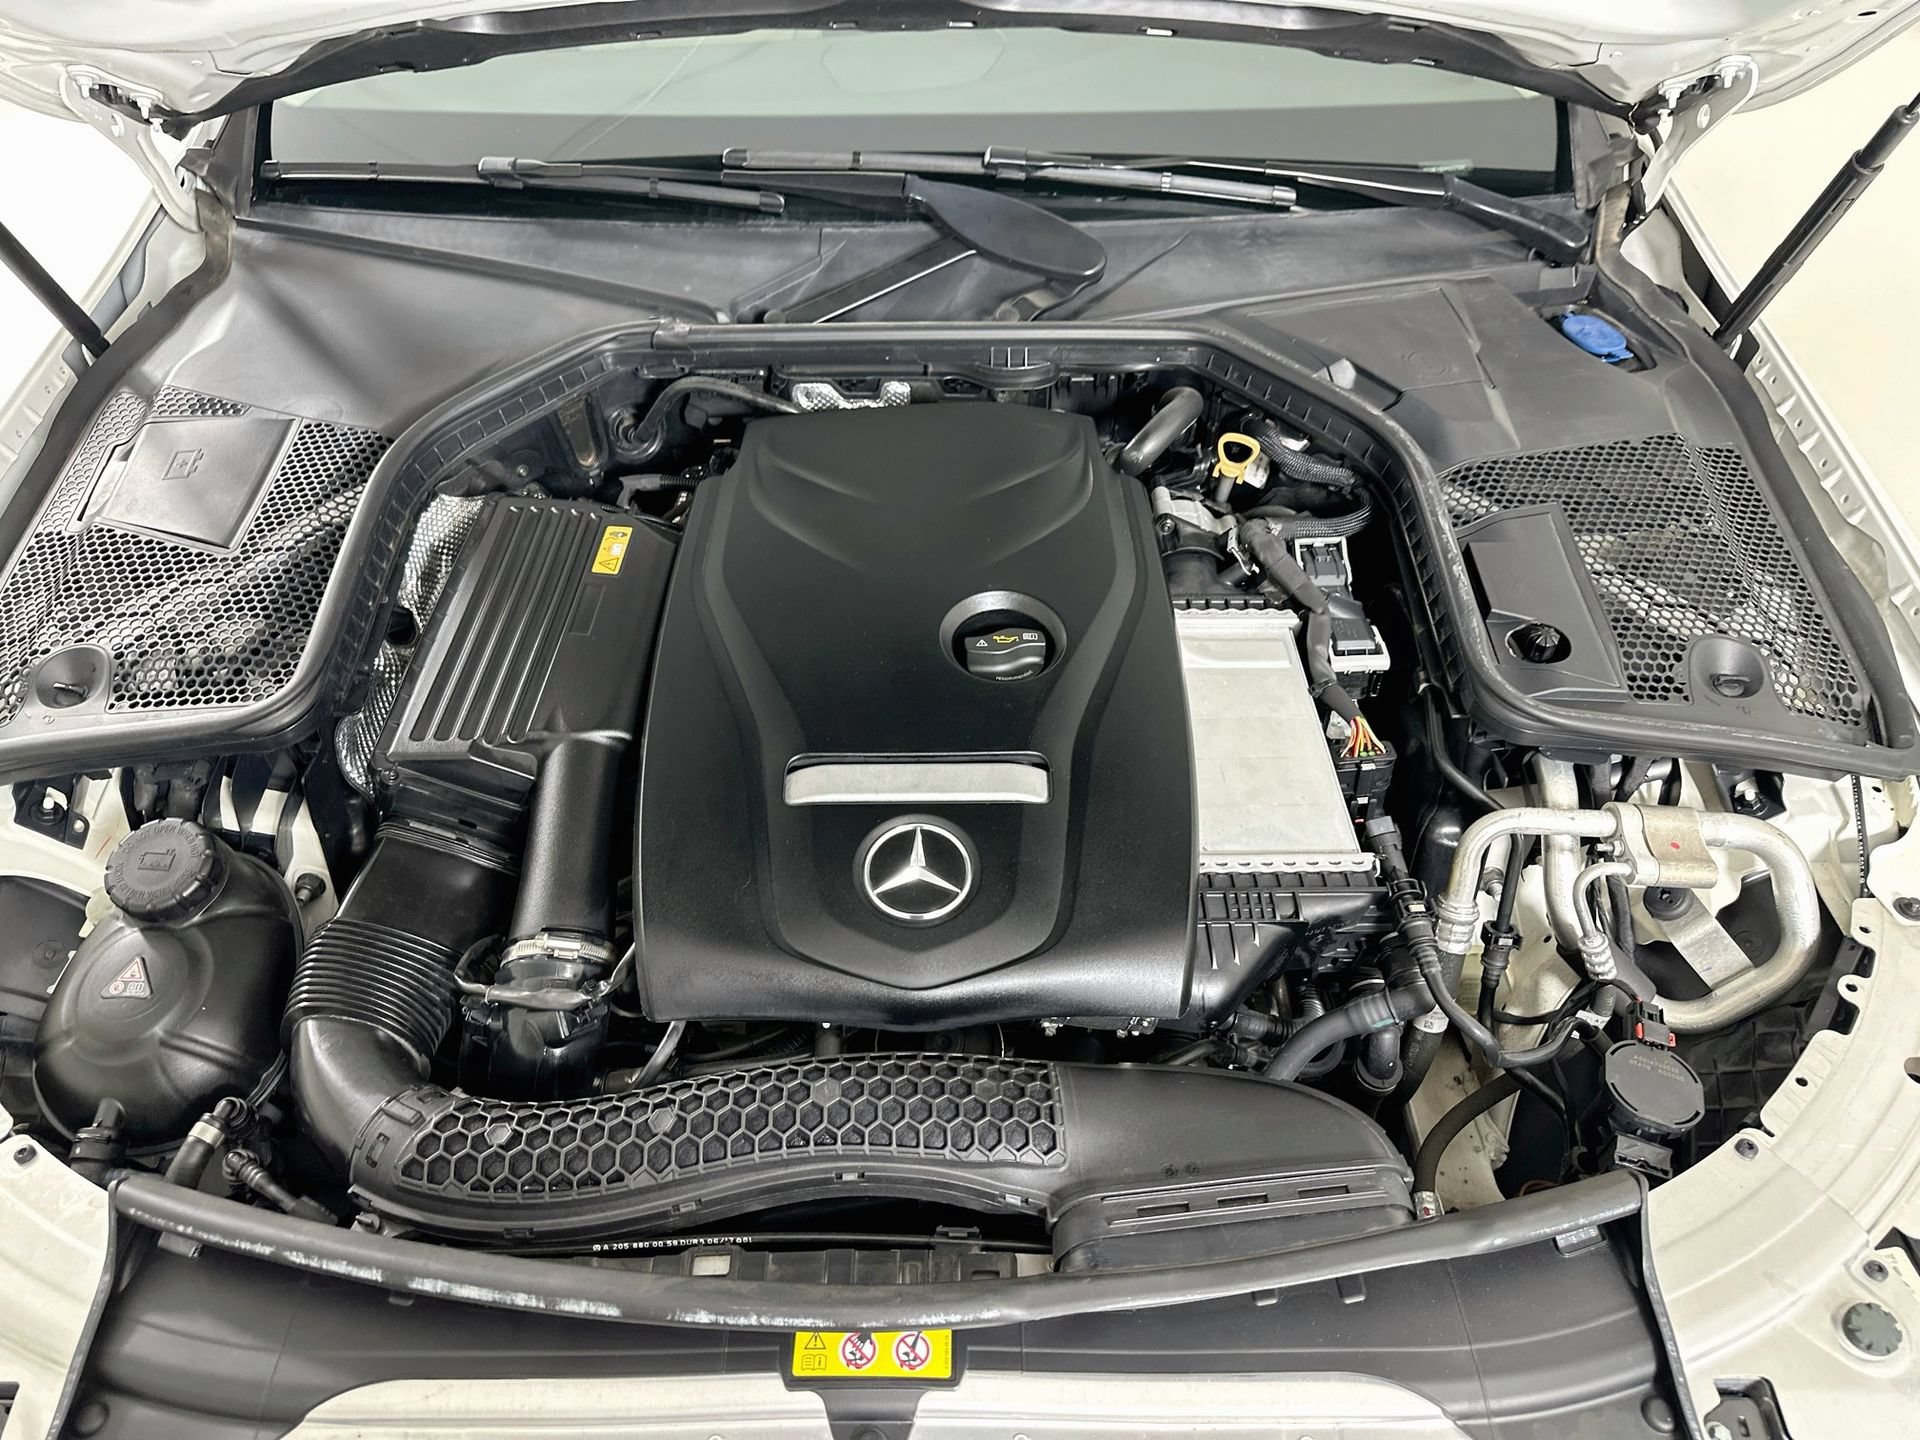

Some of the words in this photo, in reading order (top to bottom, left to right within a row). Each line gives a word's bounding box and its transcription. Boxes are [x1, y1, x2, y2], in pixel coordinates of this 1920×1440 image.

[612, 1243, 629, 1251] 205
[632, 1241, 649, 1249] 880
[652, 1240, 664, 1248] 00
